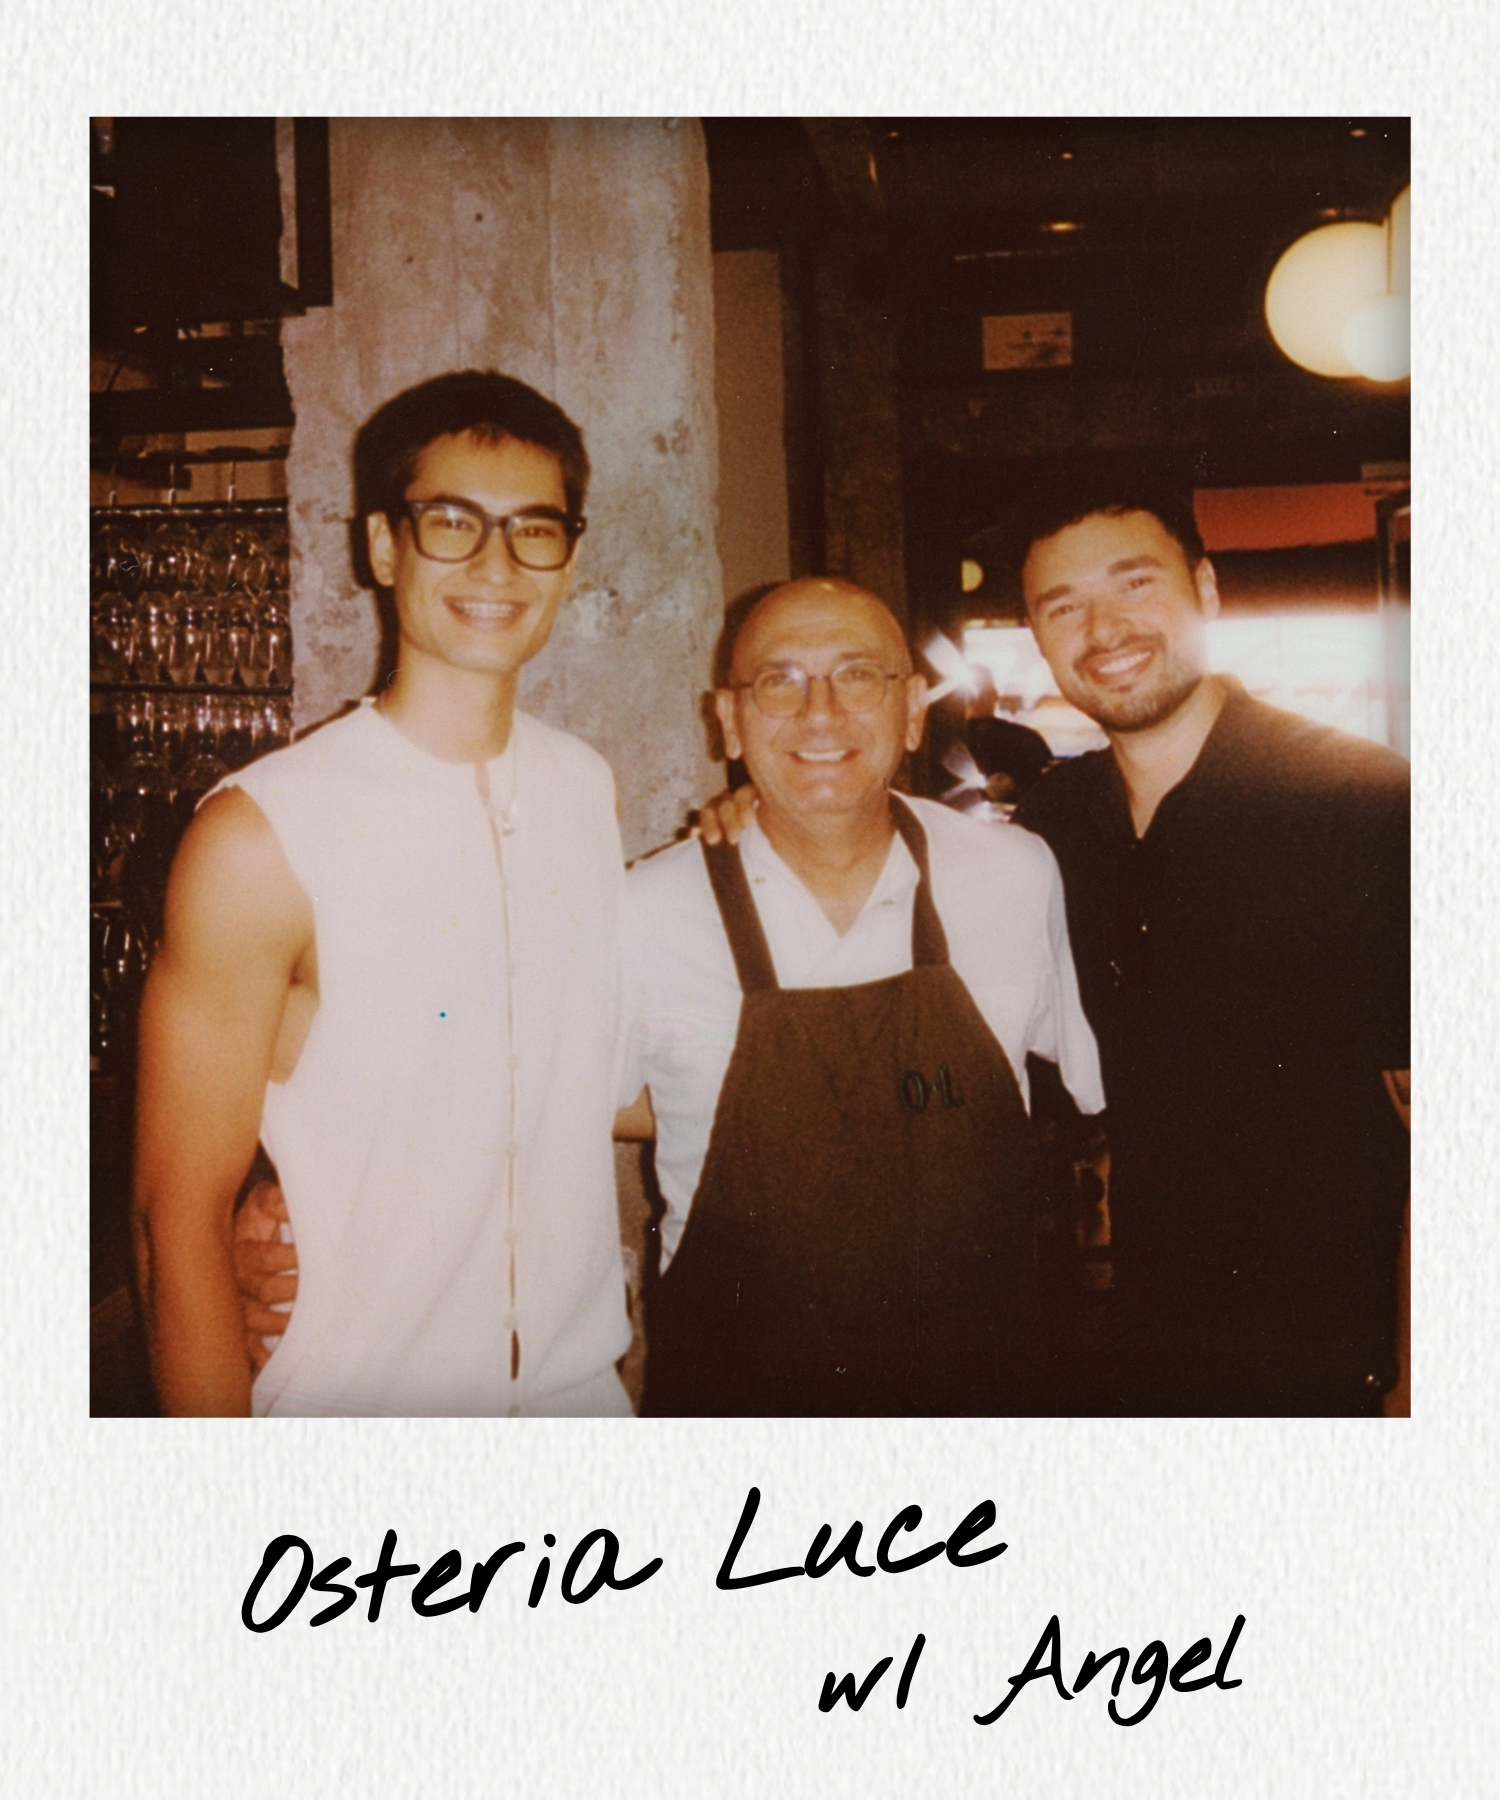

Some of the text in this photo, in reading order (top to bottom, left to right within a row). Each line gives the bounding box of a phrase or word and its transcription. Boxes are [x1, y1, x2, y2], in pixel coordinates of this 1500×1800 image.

[241, 1486, 1009, 1634] Osteria Luce
[973, 1614, 1247, 1726] Angel
